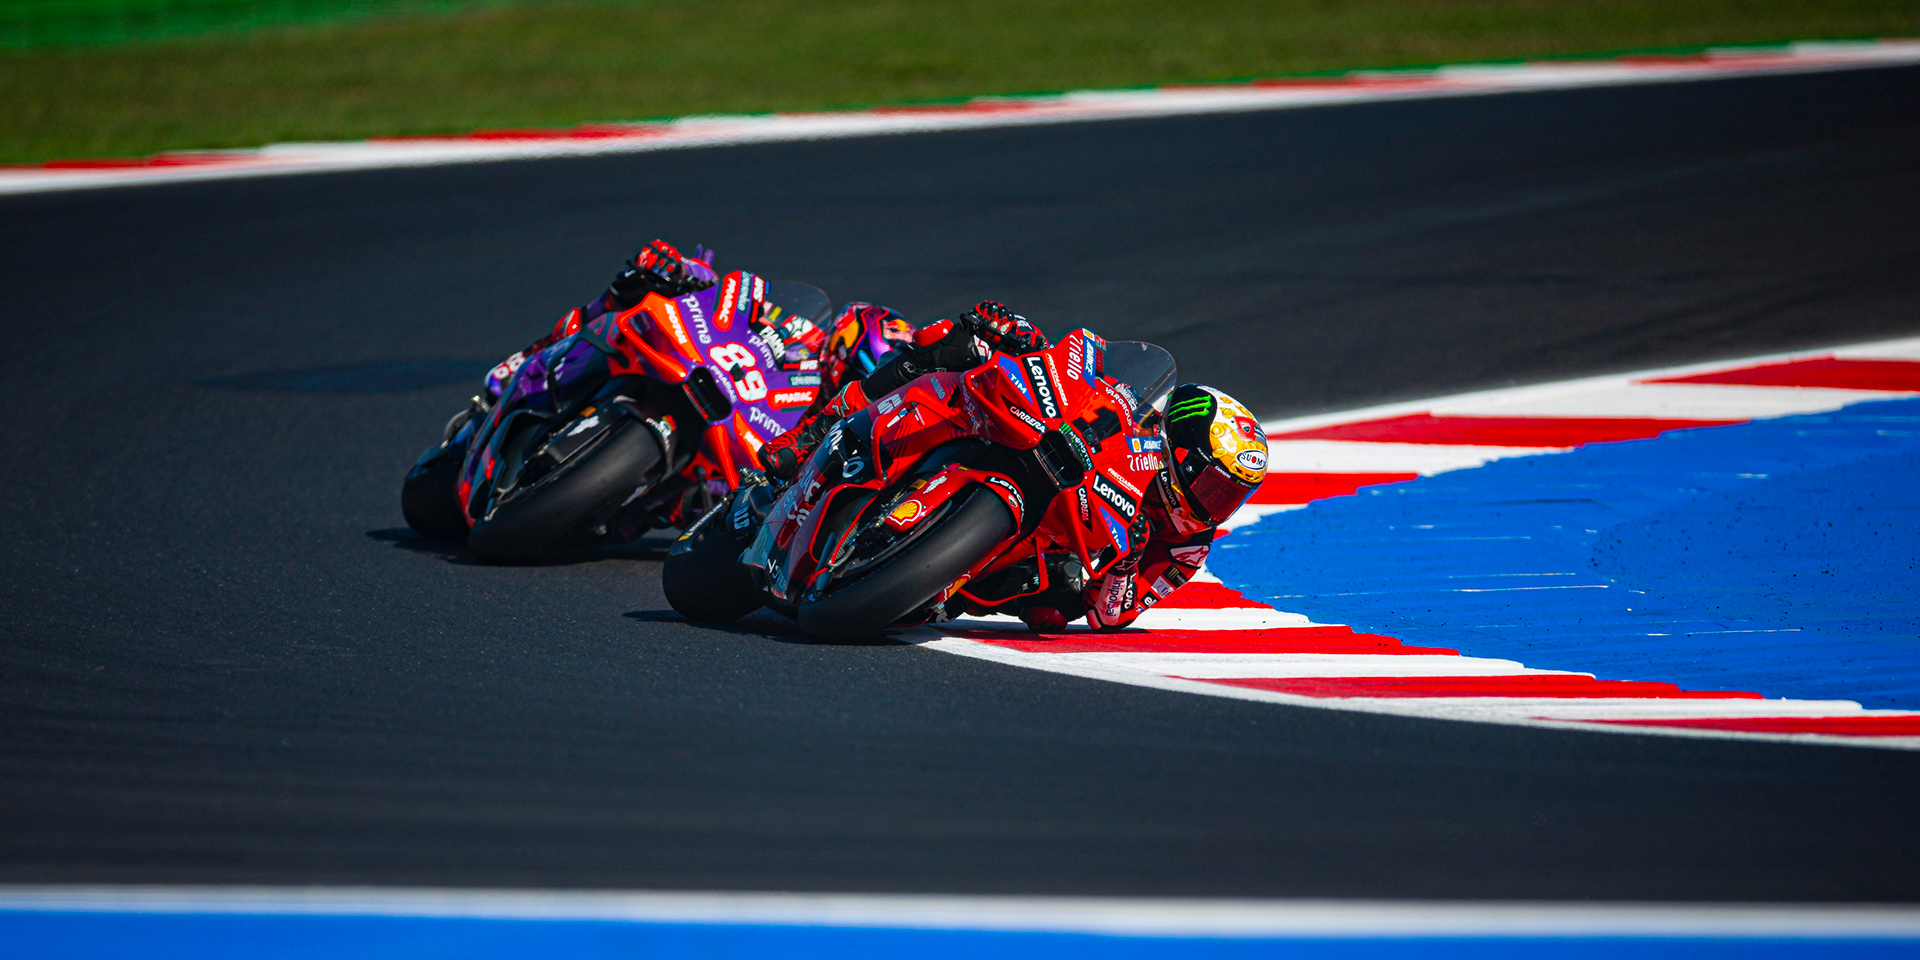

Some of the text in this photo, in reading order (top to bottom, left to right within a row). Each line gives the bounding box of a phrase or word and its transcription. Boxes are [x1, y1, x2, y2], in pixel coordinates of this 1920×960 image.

[719, 277, 737, 323] PRAMAC
[664, 303, 687, 344] MOTUL
[681, 294, 712, 345] prima
[748, 334, 774, 369] prima
[709, 342, 768, 401] 89
[1011, 373, 1027, 394] TIM
[1026, 356, 1057, 418] Lenovo
[774, 391, 812, 403] PRAMAC
[1010, 406, 1046, 433] CARRERA
[1093, 475, 1135, 517] Lenovo
[1108, 467, 1143, 497] FRECCIAROSSA
[1160, 471, 1177, 506] Lenovo
[1124, 573, 1137, 609] Lovo
